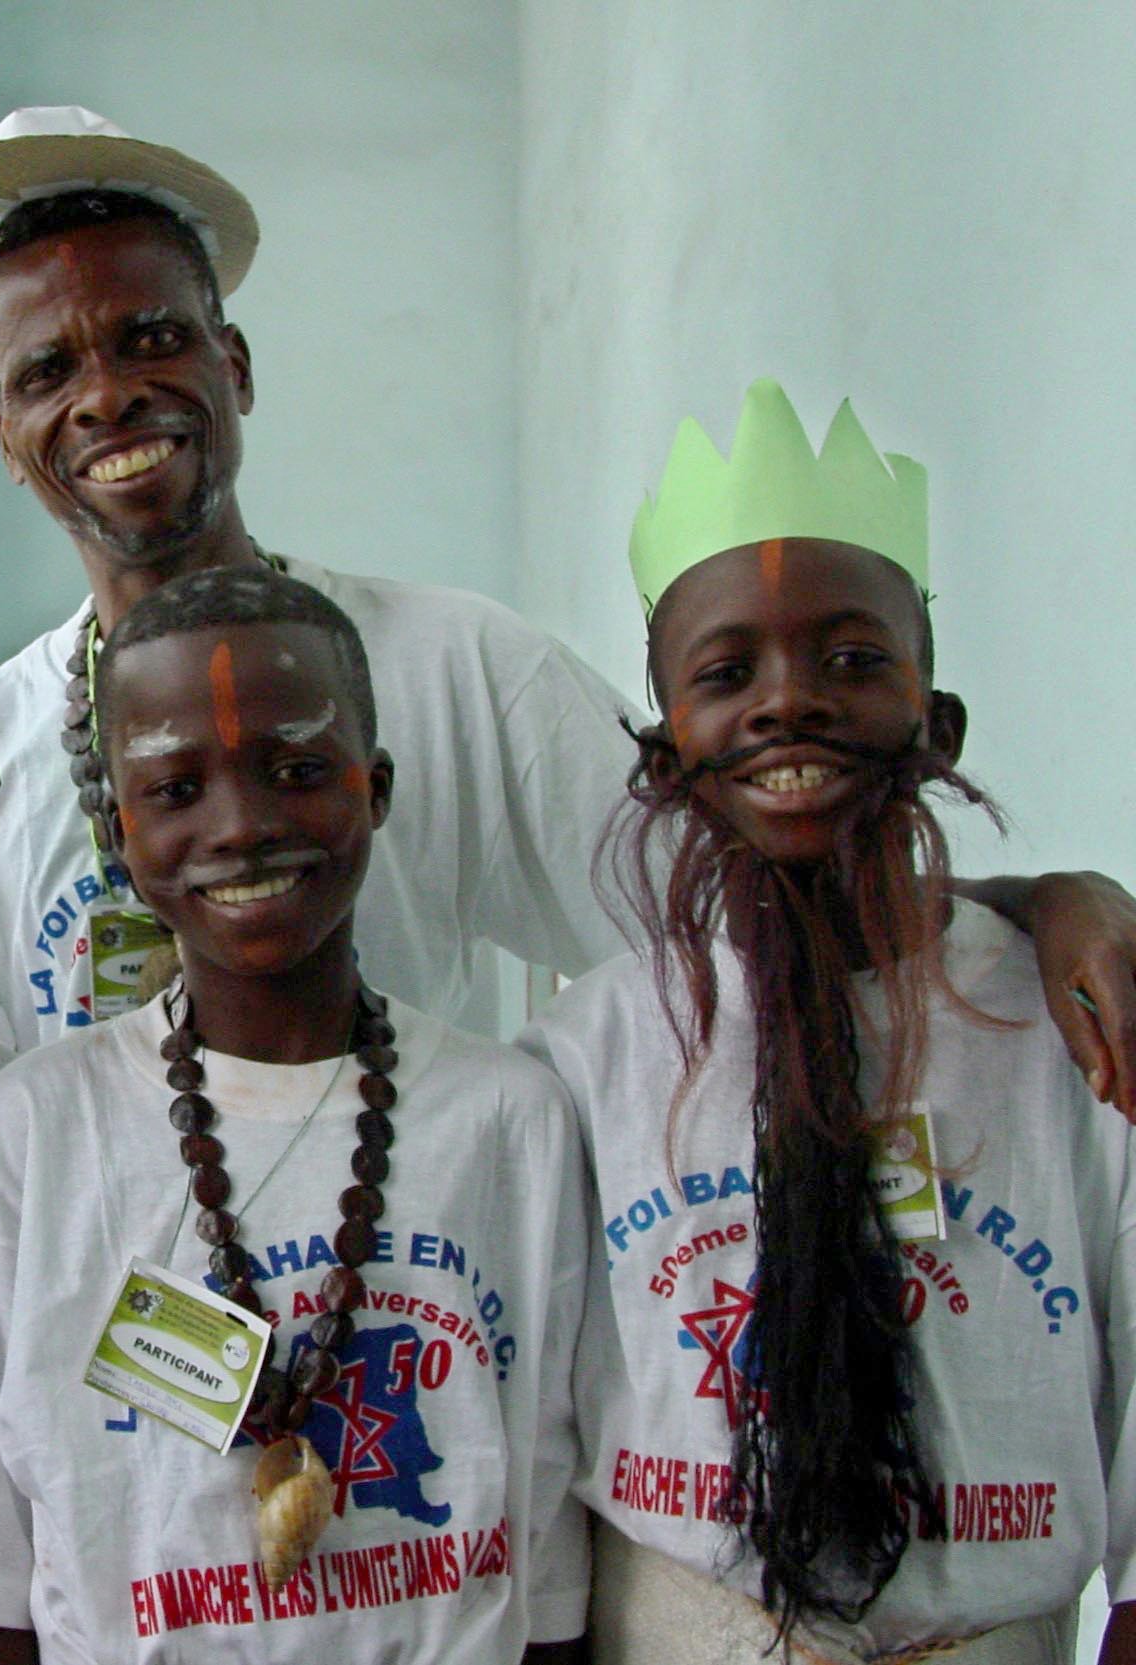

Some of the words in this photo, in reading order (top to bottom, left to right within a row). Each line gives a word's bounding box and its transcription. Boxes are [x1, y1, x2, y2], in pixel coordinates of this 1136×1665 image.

[35, 896, 77, 958] FOI
[30, 968, 57, 1015] LA
[409, 1233, 466, 1276] EN
[605, 1187, 672, 1252] FOI
[976, 1204, 1079, 1334] R.D.C.
[133, 1336, 224, 1391] PARTICIPANT
[385, 1339, 452, 1397] 50
[953, 1482, 1057, 1542] DIVERSITE
[131, 1577, 160, 1638] EN
[155, 1564, 255, 1631] MARCHE
[317, 1543, 402, 1613] L'UNITE
[401, 1533, 461, 1600] DANS
